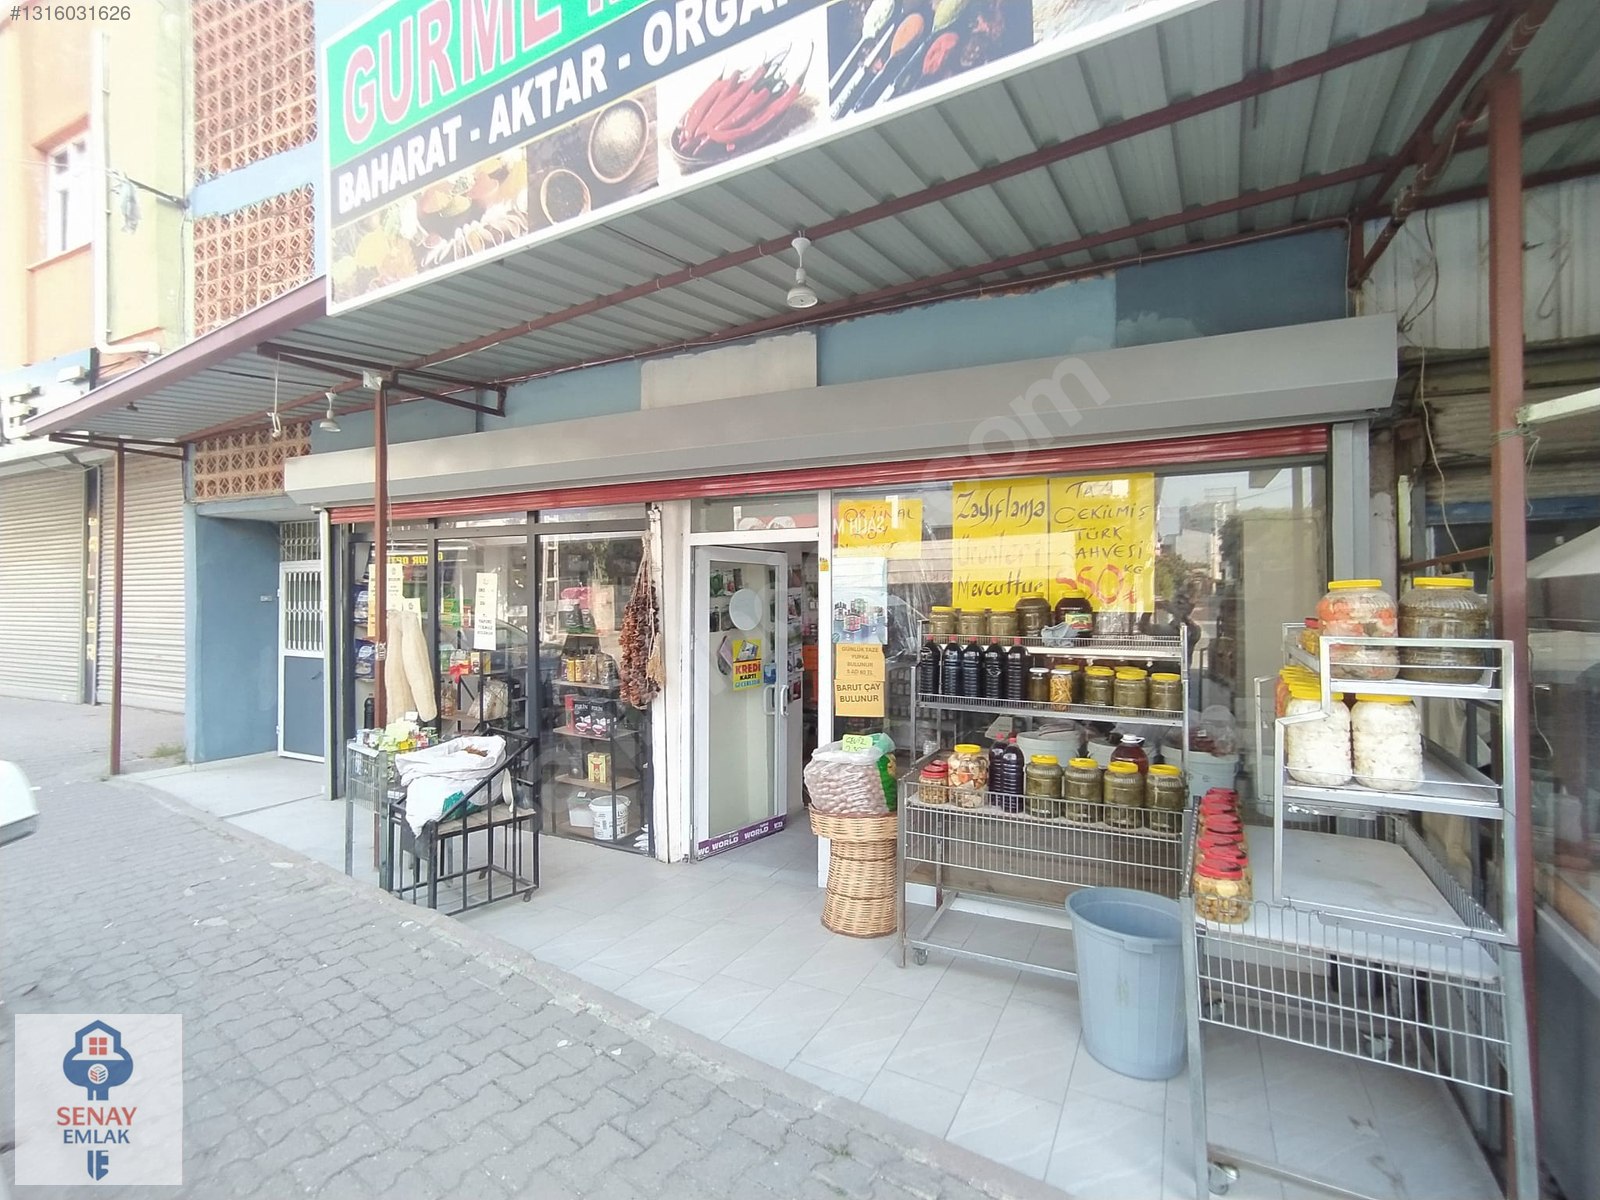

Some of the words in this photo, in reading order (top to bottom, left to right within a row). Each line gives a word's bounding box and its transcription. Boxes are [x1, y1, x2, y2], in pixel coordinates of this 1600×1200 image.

[338, 115, 462, 214] BAHARAT
[488, 43, 608, 145] AKTAR
[643, 0, 789, 66] ORG
[1060, 525, 1125, 541] TÜRK
[836, 683, 863, 692] BARUT
[863, 683, 881, 693] ÇAY
[839, 694, 880, 703] BULUNUR
[711, 836, 739, 850] WORLD
[743, 826, 769, 840] WORLD
